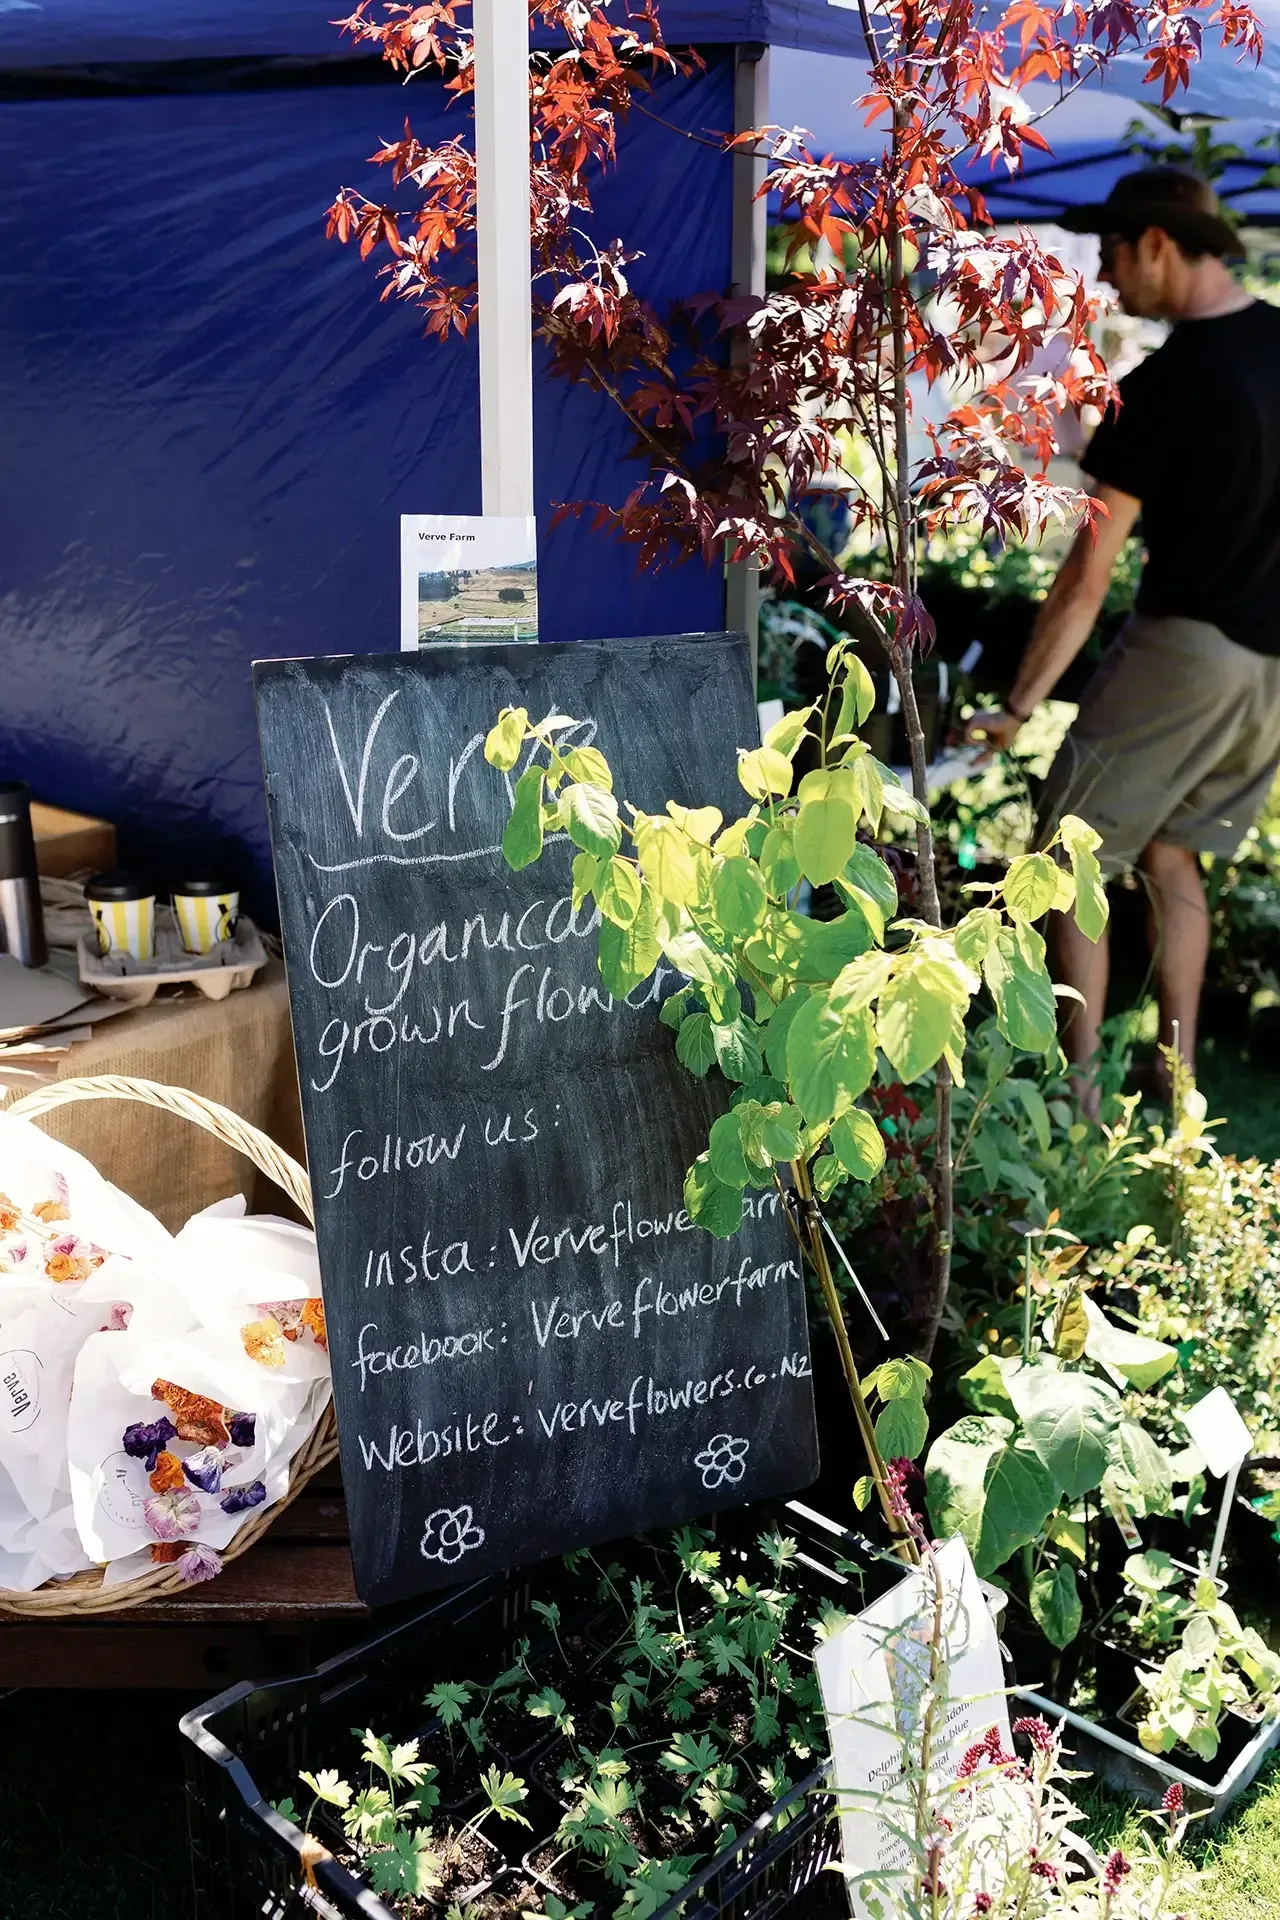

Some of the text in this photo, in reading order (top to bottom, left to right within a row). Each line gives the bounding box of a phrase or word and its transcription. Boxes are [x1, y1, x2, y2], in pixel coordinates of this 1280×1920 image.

[418, 532, 476, 541] Verve Farm
[311, 963, 693, 1093] grown flowr
[324, 1123, 466, 1199] follow
[508, 1190, 797, 1268] Verveflowearm
[3, 1372, 31, 1417] Verve
[948, 1719, 970, 1741] blue
